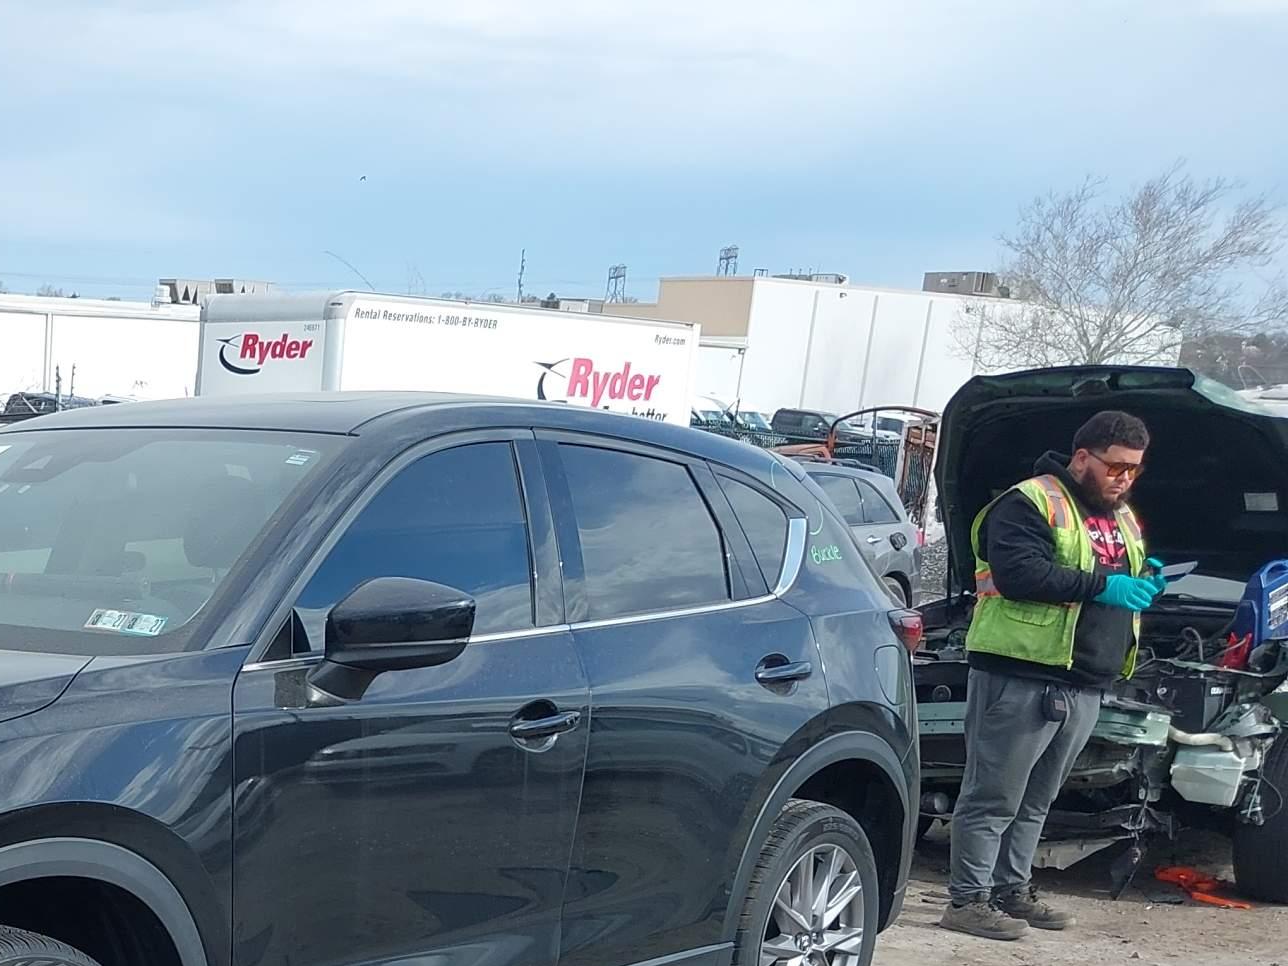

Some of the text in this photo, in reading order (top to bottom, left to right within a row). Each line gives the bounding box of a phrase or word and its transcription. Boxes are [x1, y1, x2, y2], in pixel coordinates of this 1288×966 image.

[355, 308, 499, 330] Rental Reservations: 1-800-BY-RYDER
[240, 333, 314, 366] Ryder
[654, 334, 687, 346] Ryder.com
[566, 357, 662, 408] Ryder
